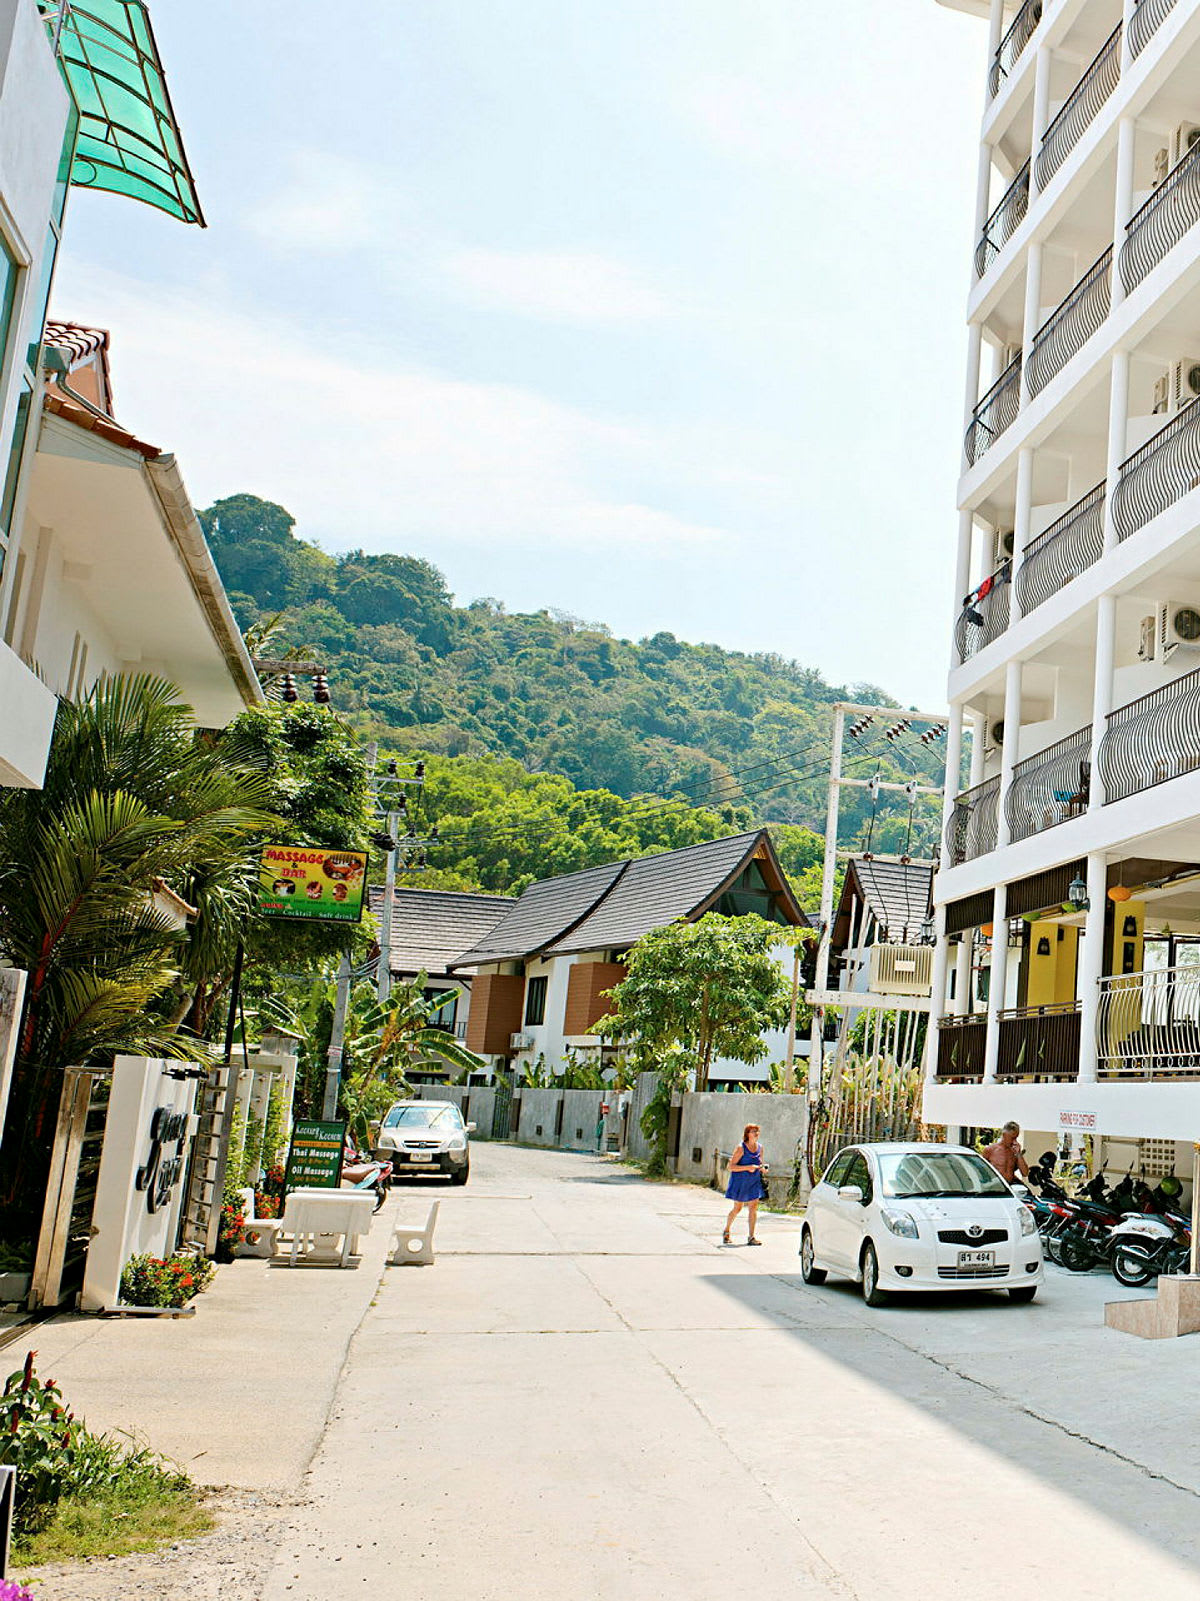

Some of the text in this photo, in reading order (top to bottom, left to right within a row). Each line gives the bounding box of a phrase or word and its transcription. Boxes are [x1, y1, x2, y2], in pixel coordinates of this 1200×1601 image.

[265, 850, 324, 865] MASSAGE
[293, 1148, 339, 1160] Thai Massage
[291, 1166, 334, 1178] Oil Massage
